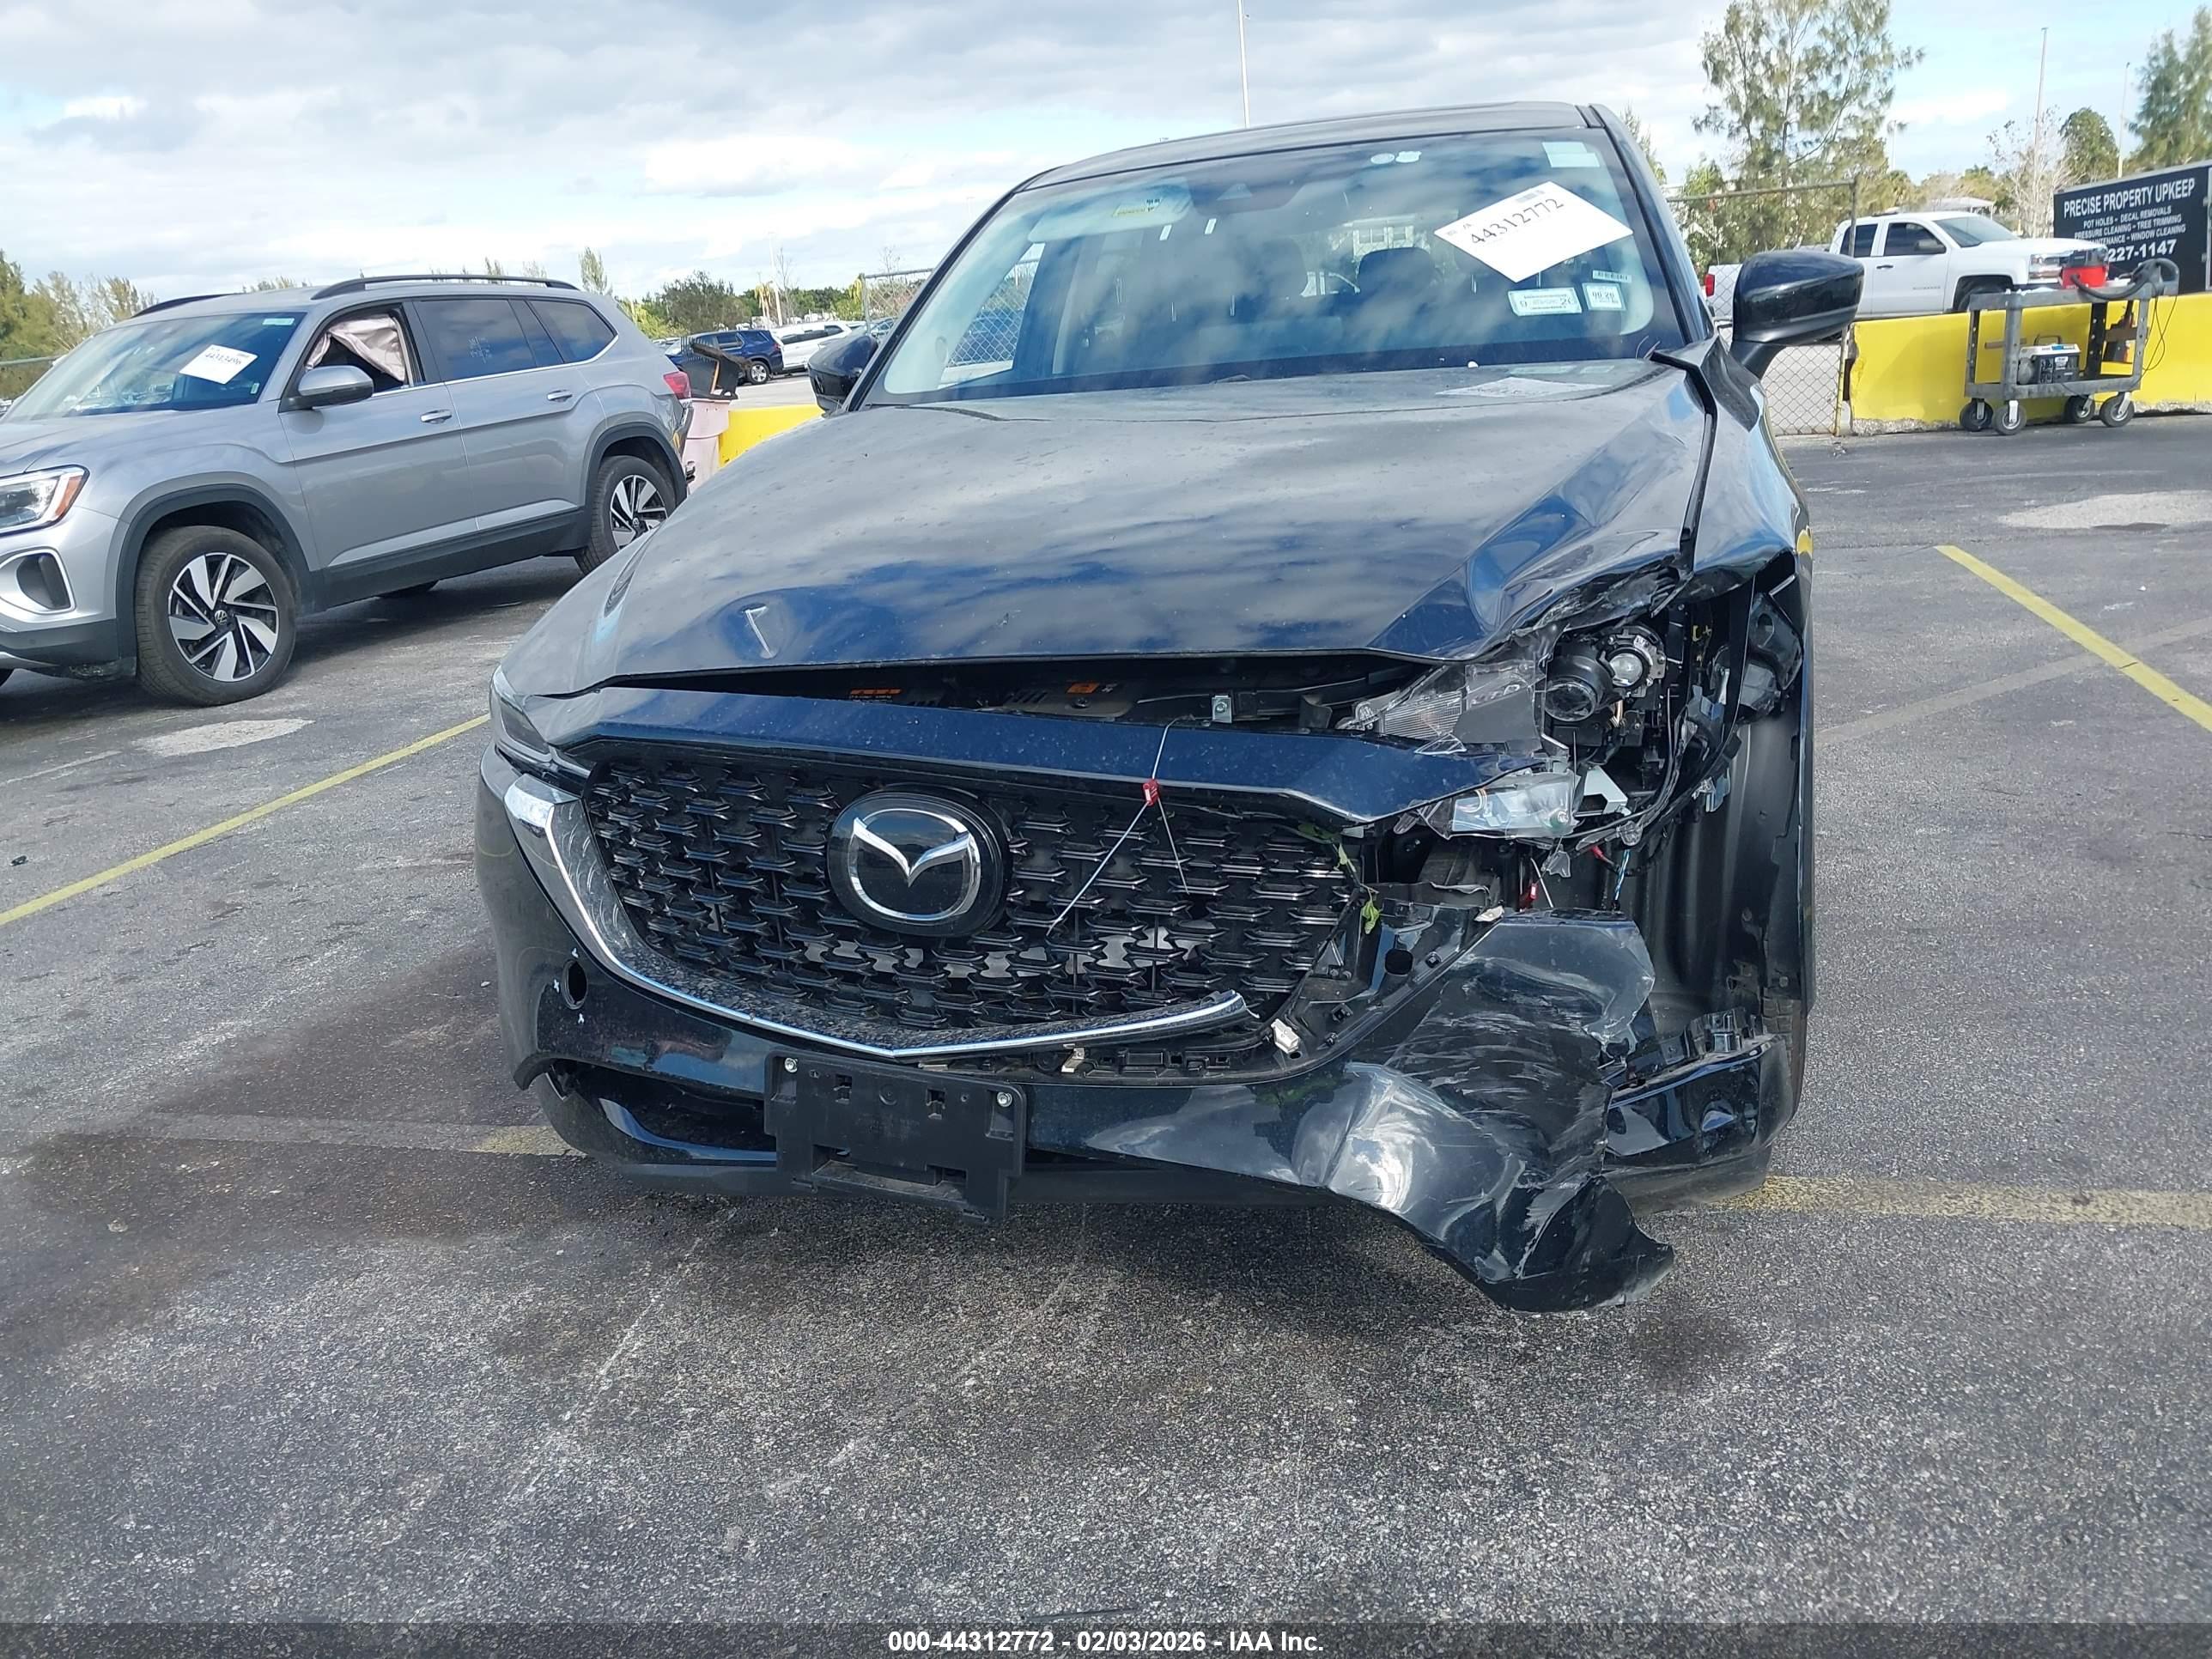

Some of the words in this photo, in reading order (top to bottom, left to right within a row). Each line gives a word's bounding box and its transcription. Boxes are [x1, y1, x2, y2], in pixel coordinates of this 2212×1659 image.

[2063, 197, 2101, 219] PRECISE
[2103, 185, 2154, 212] PROPERTY
[2155, 177, 2195, 204] UPKEEP
[1471, 198, 1565, 244] 44312772
[2074, 228, 2103, 240] PRESSURE
[2104, 222, 2131, 236] CLEANING
[2137, 219, 2152, 230] TREE
[2153, 213, 2182, 227] TRIMMING
[2083, 218, 2095, 229] POT
[2095, 216, 2114, 228] HOLES
[2120, 211, 2139, 223] DECAL
[2140, 205, 2172, 220] REMOVALS
[2130, 228, 2155, 241] WINDOW
[2155, 223, 2186, 238] CLEANING
